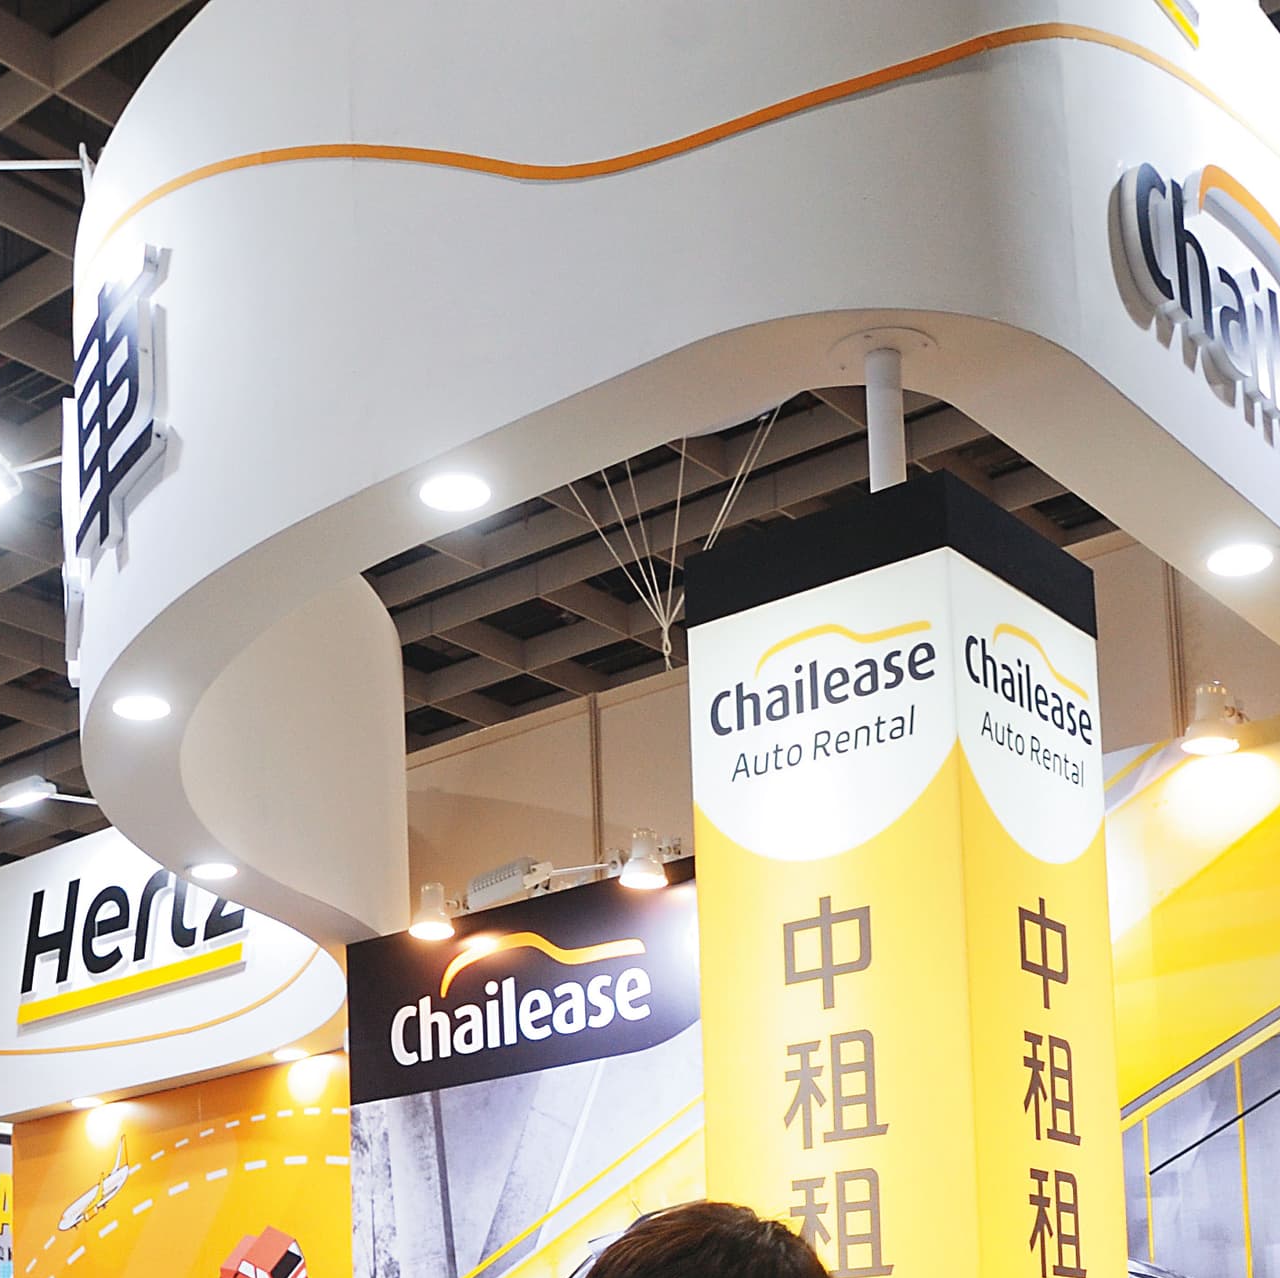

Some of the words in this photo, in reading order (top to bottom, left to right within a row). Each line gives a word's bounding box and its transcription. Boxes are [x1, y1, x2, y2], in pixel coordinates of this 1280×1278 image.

[710, 640, 936, 737] Chailease
[965, 634, 1093, 746] Chailease
[731, 740, 803, 783] Auto
[812, 706, 916, 761] Rental
[980, 710, 1027, 755] Auto
[1029, 736, 1086, 789] Rental
[391, 967, 651, 1067] Chailease
